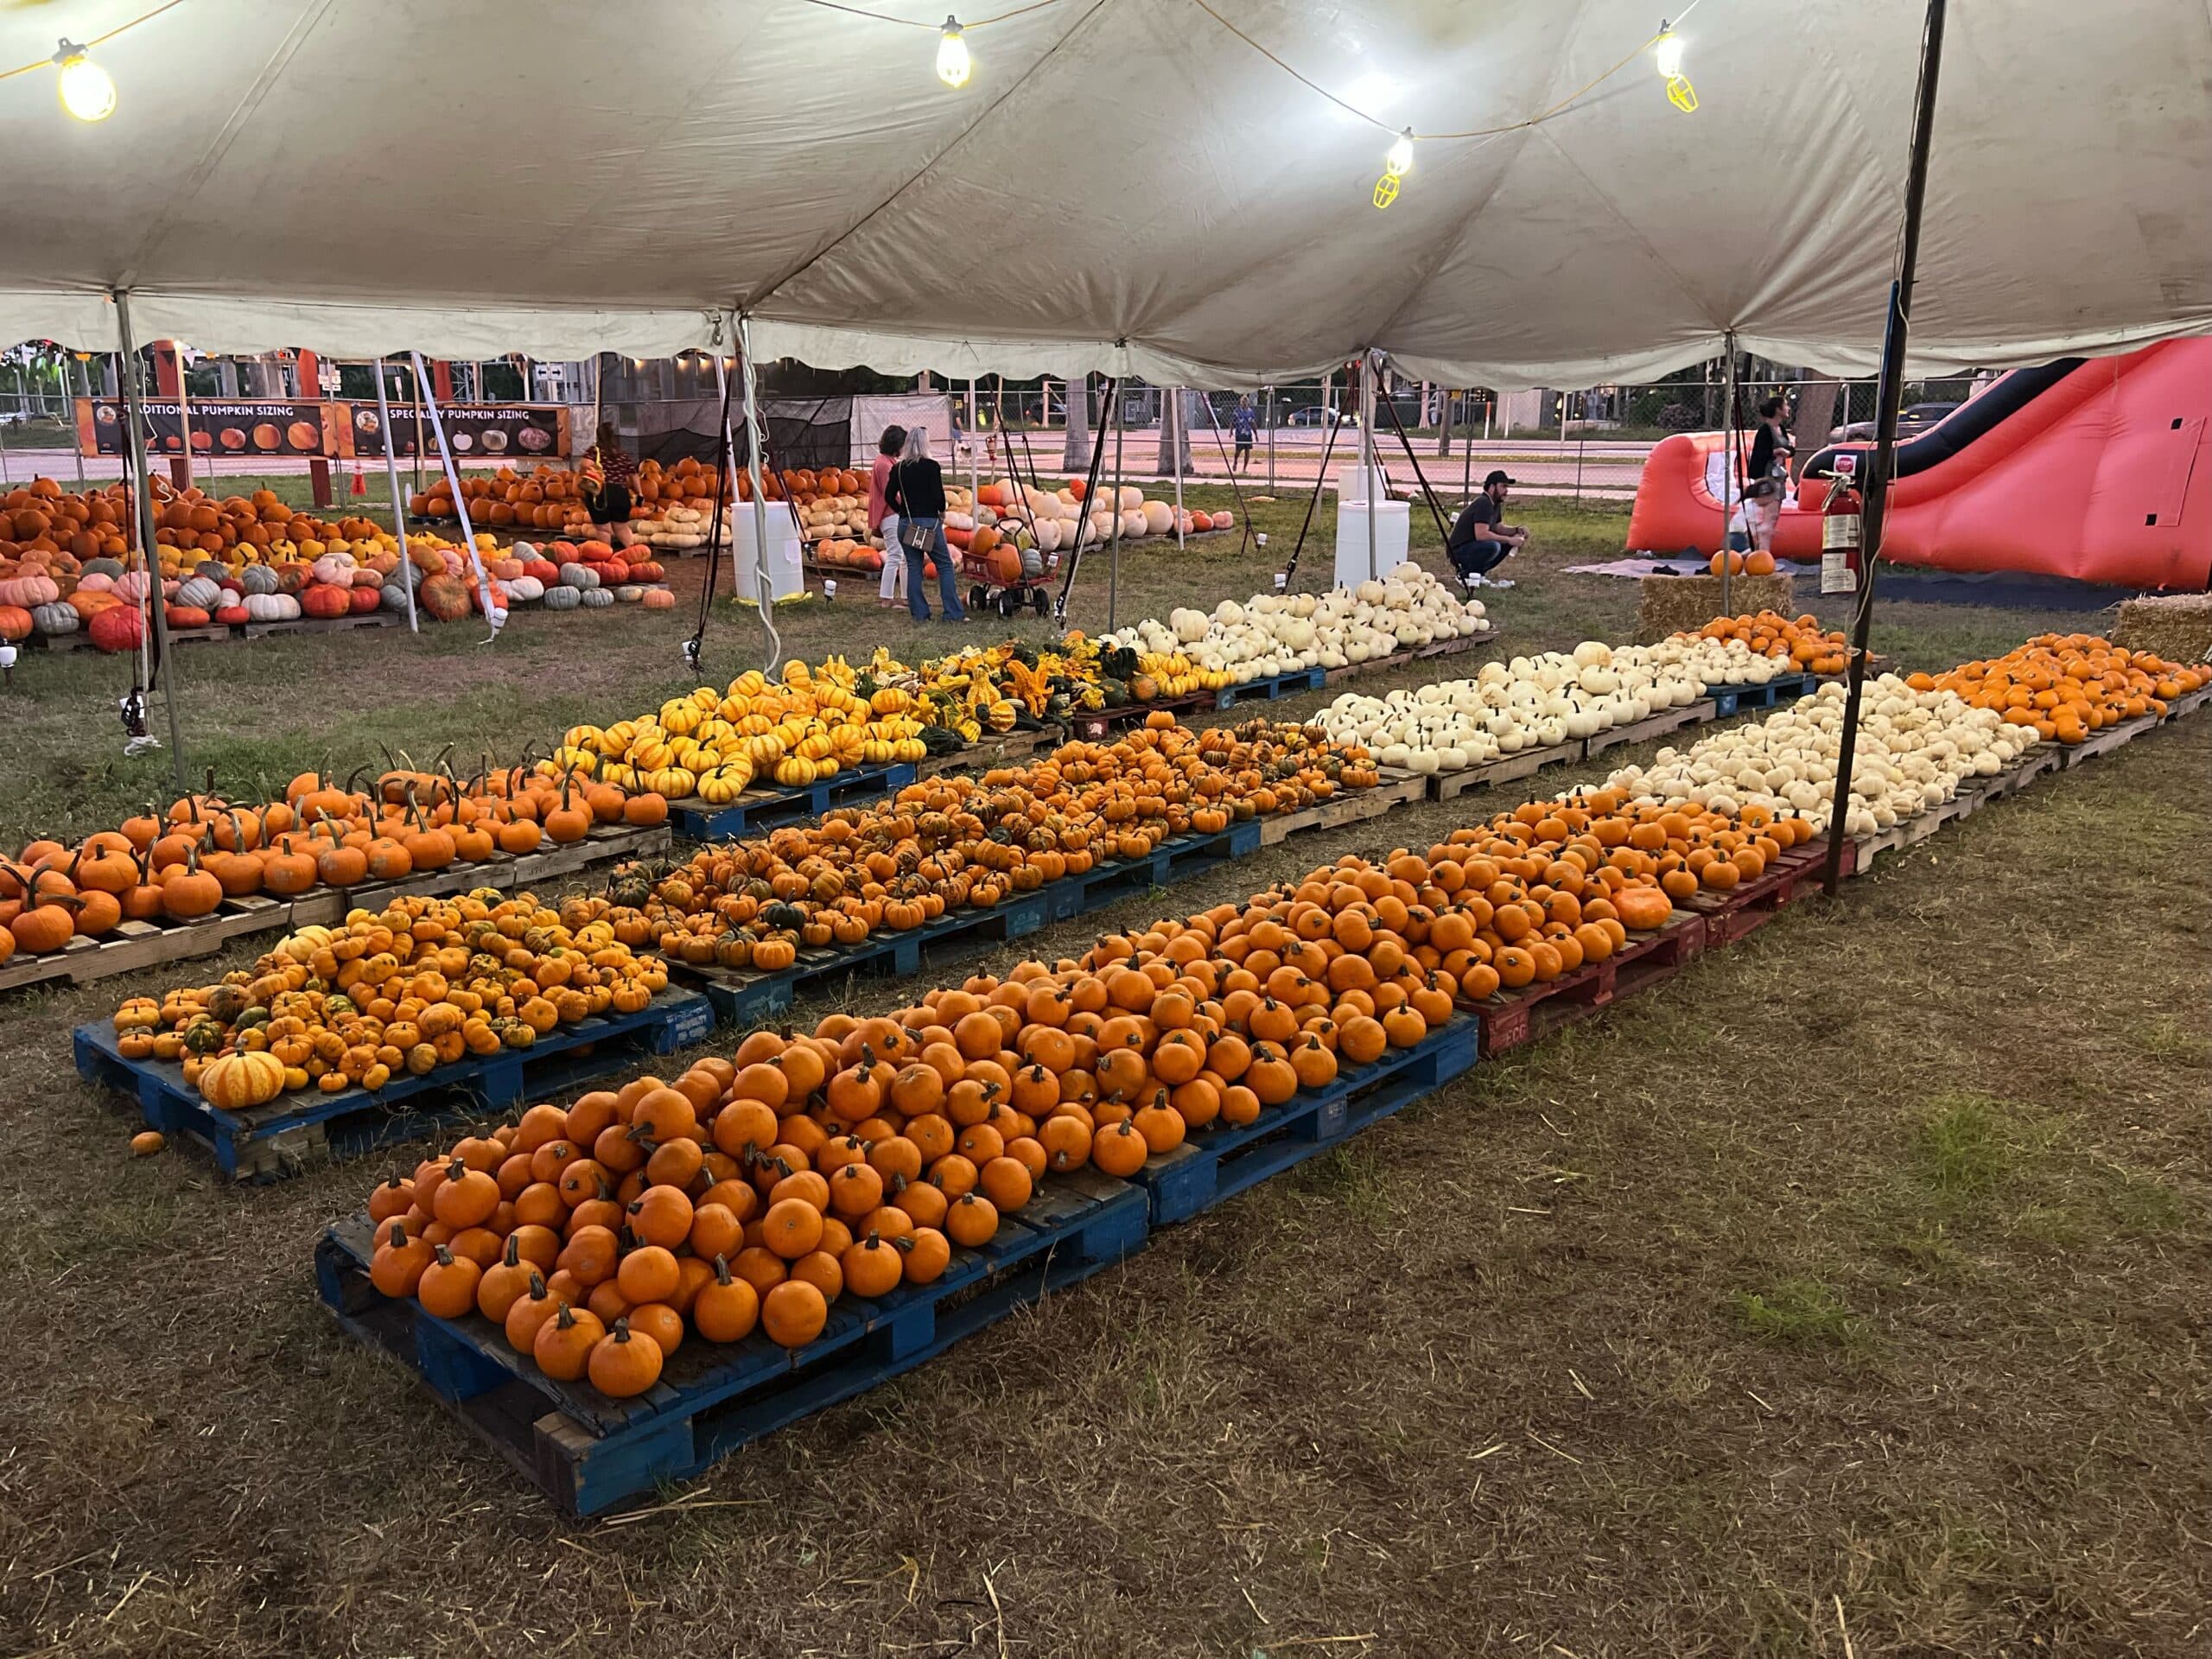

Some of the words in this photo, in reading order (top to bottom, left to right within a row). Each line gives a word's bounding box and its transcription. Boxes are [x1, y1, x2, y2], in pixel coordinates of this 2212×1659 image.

[124, 404, 199, 415] TADITIONAL
[201, 406, 254, 416] PUMPKIN
[257, 407, 294, 416] SIZING
[390, 410, 444, 419] SPECALY
[448, 410, 494, 419] PUMPKIN
[497, 411, 529, 420] SIZING
